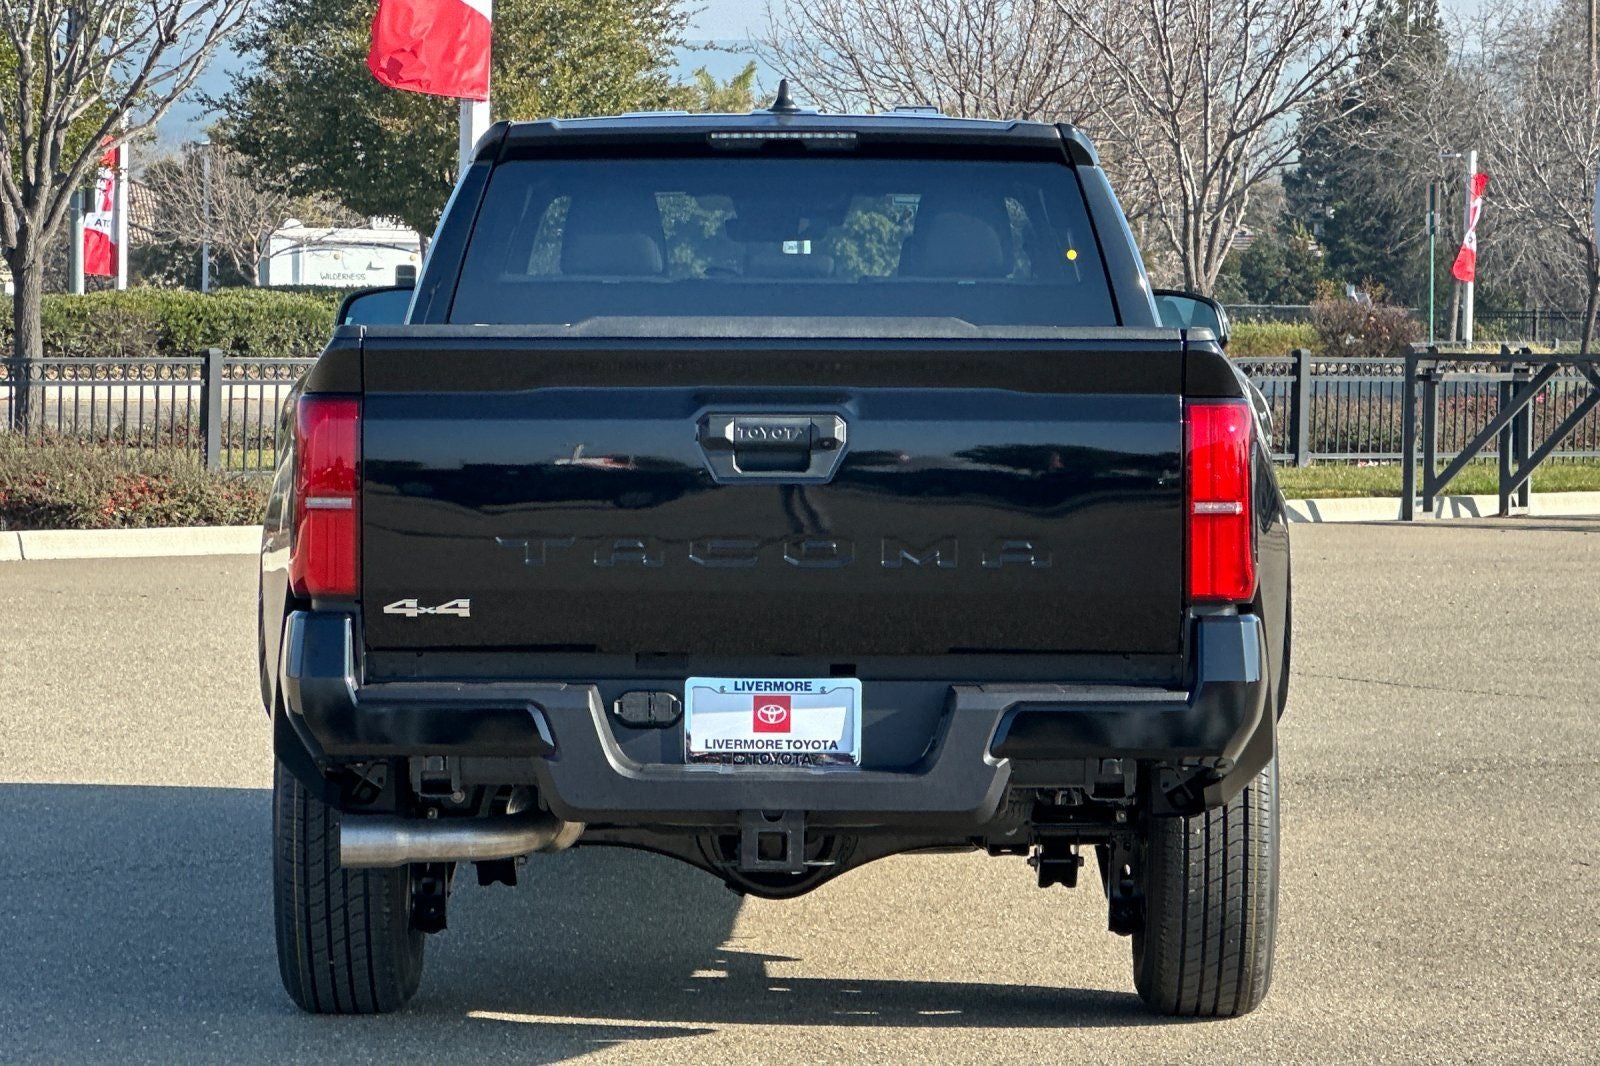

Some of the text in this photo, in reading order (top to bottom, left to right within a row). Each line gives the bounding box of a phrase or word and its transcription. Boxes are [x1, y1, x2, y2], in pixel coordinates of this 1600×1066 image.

[319, 272, 366, 281] WILDERNESS
[737, 425, 806, 441] TOYOTA
[495, 535, 1053, 568] TACOMA
[733, 680, 813, 692] LIVERMORE
[704, 738, 839, 751] LIVERMORE TOYOTA
[750, 752, 812, 765] TOYOTA
